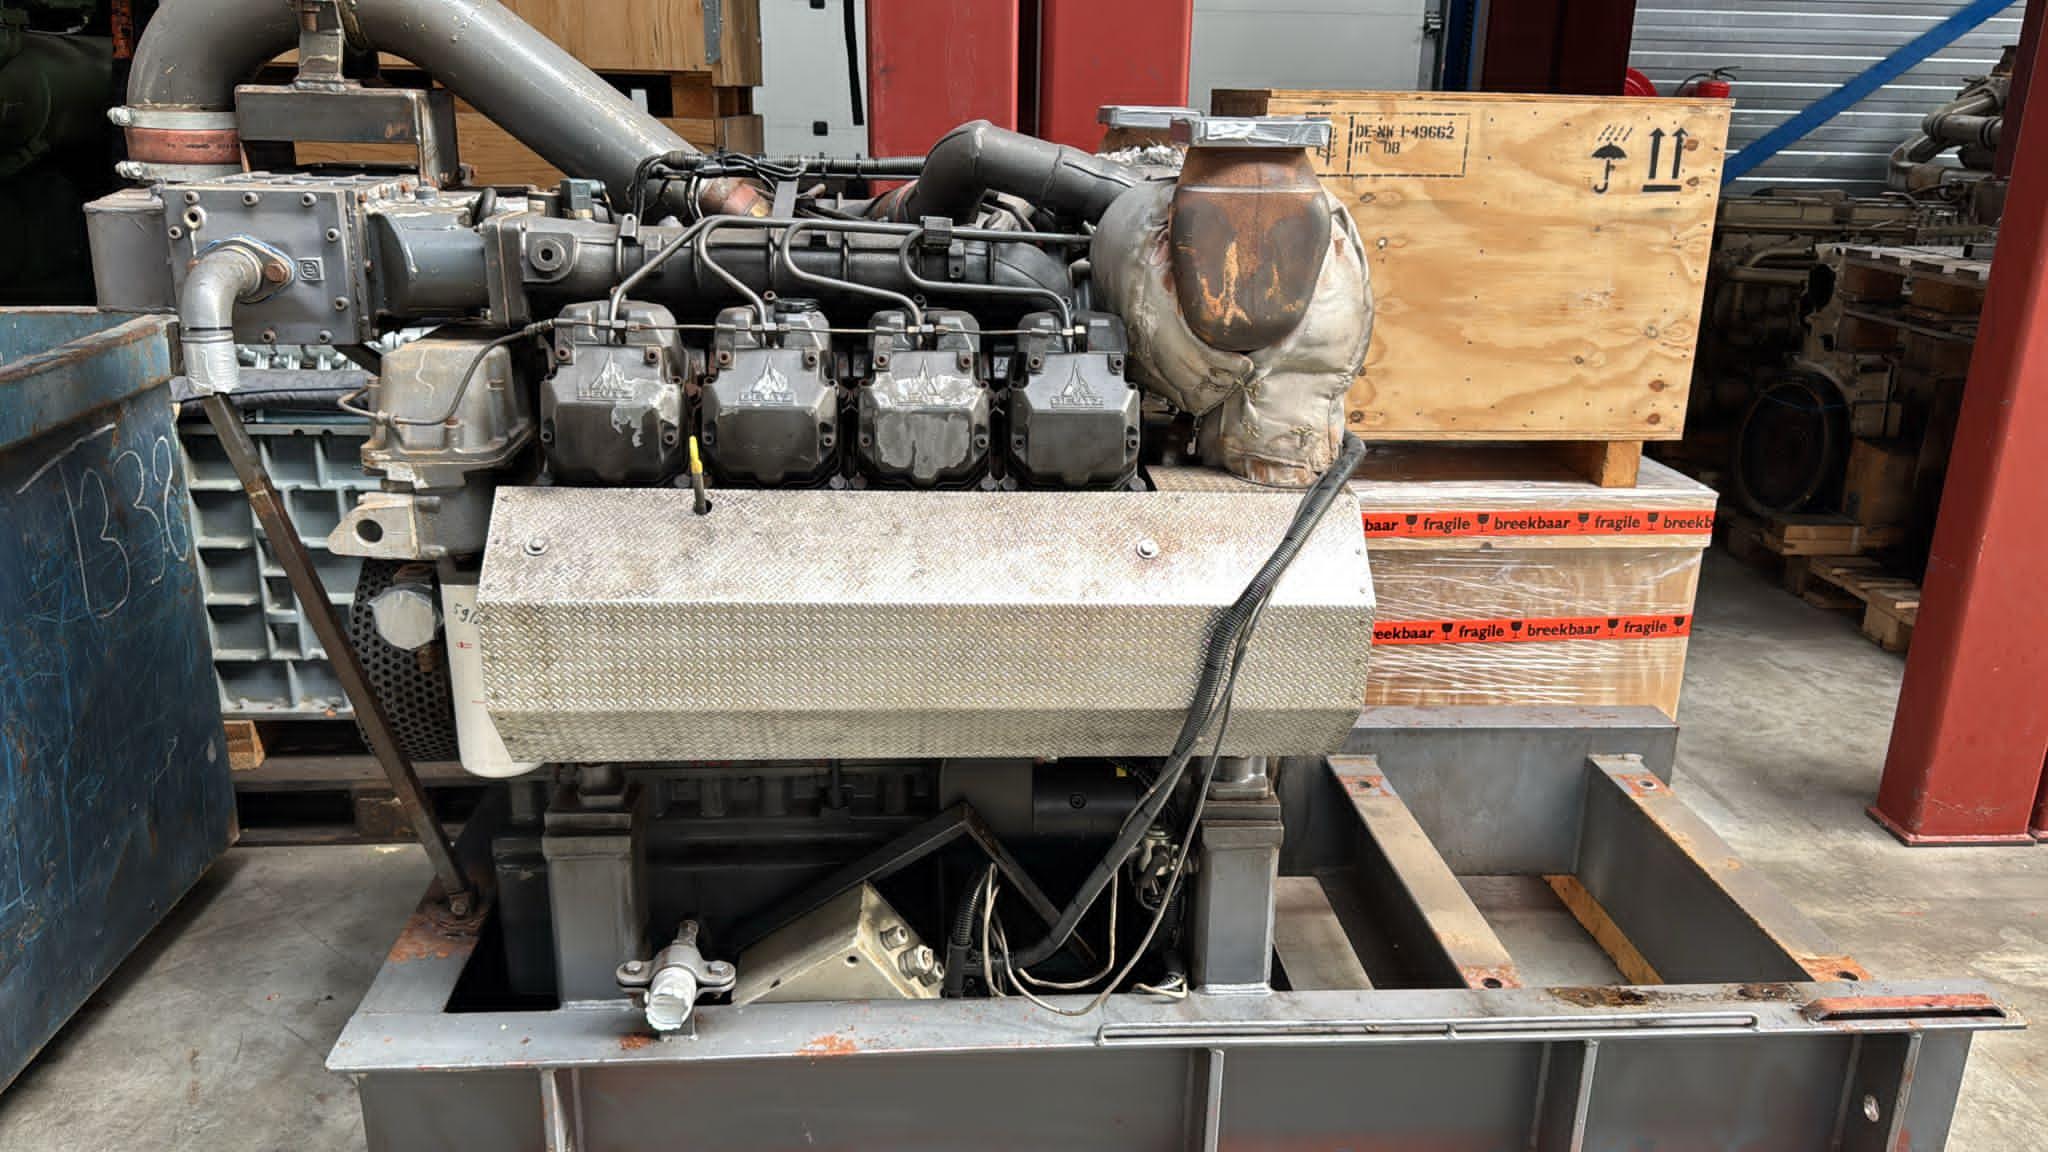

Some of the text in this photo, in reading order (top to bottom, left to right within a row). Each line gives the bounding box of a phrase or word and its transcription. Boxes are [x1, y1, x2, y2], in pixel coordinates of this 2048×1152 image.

[1423, 516, 1471, 534] fragile
[1494, 515, 1571, 530] breekbaar
[1595, 514, 1641, 532] fragile
[1459, 623, 1505, 641] fragile
[1527, 622, 1601, 637] breekbaar
[1624, 619, 1668, 636] fragile
